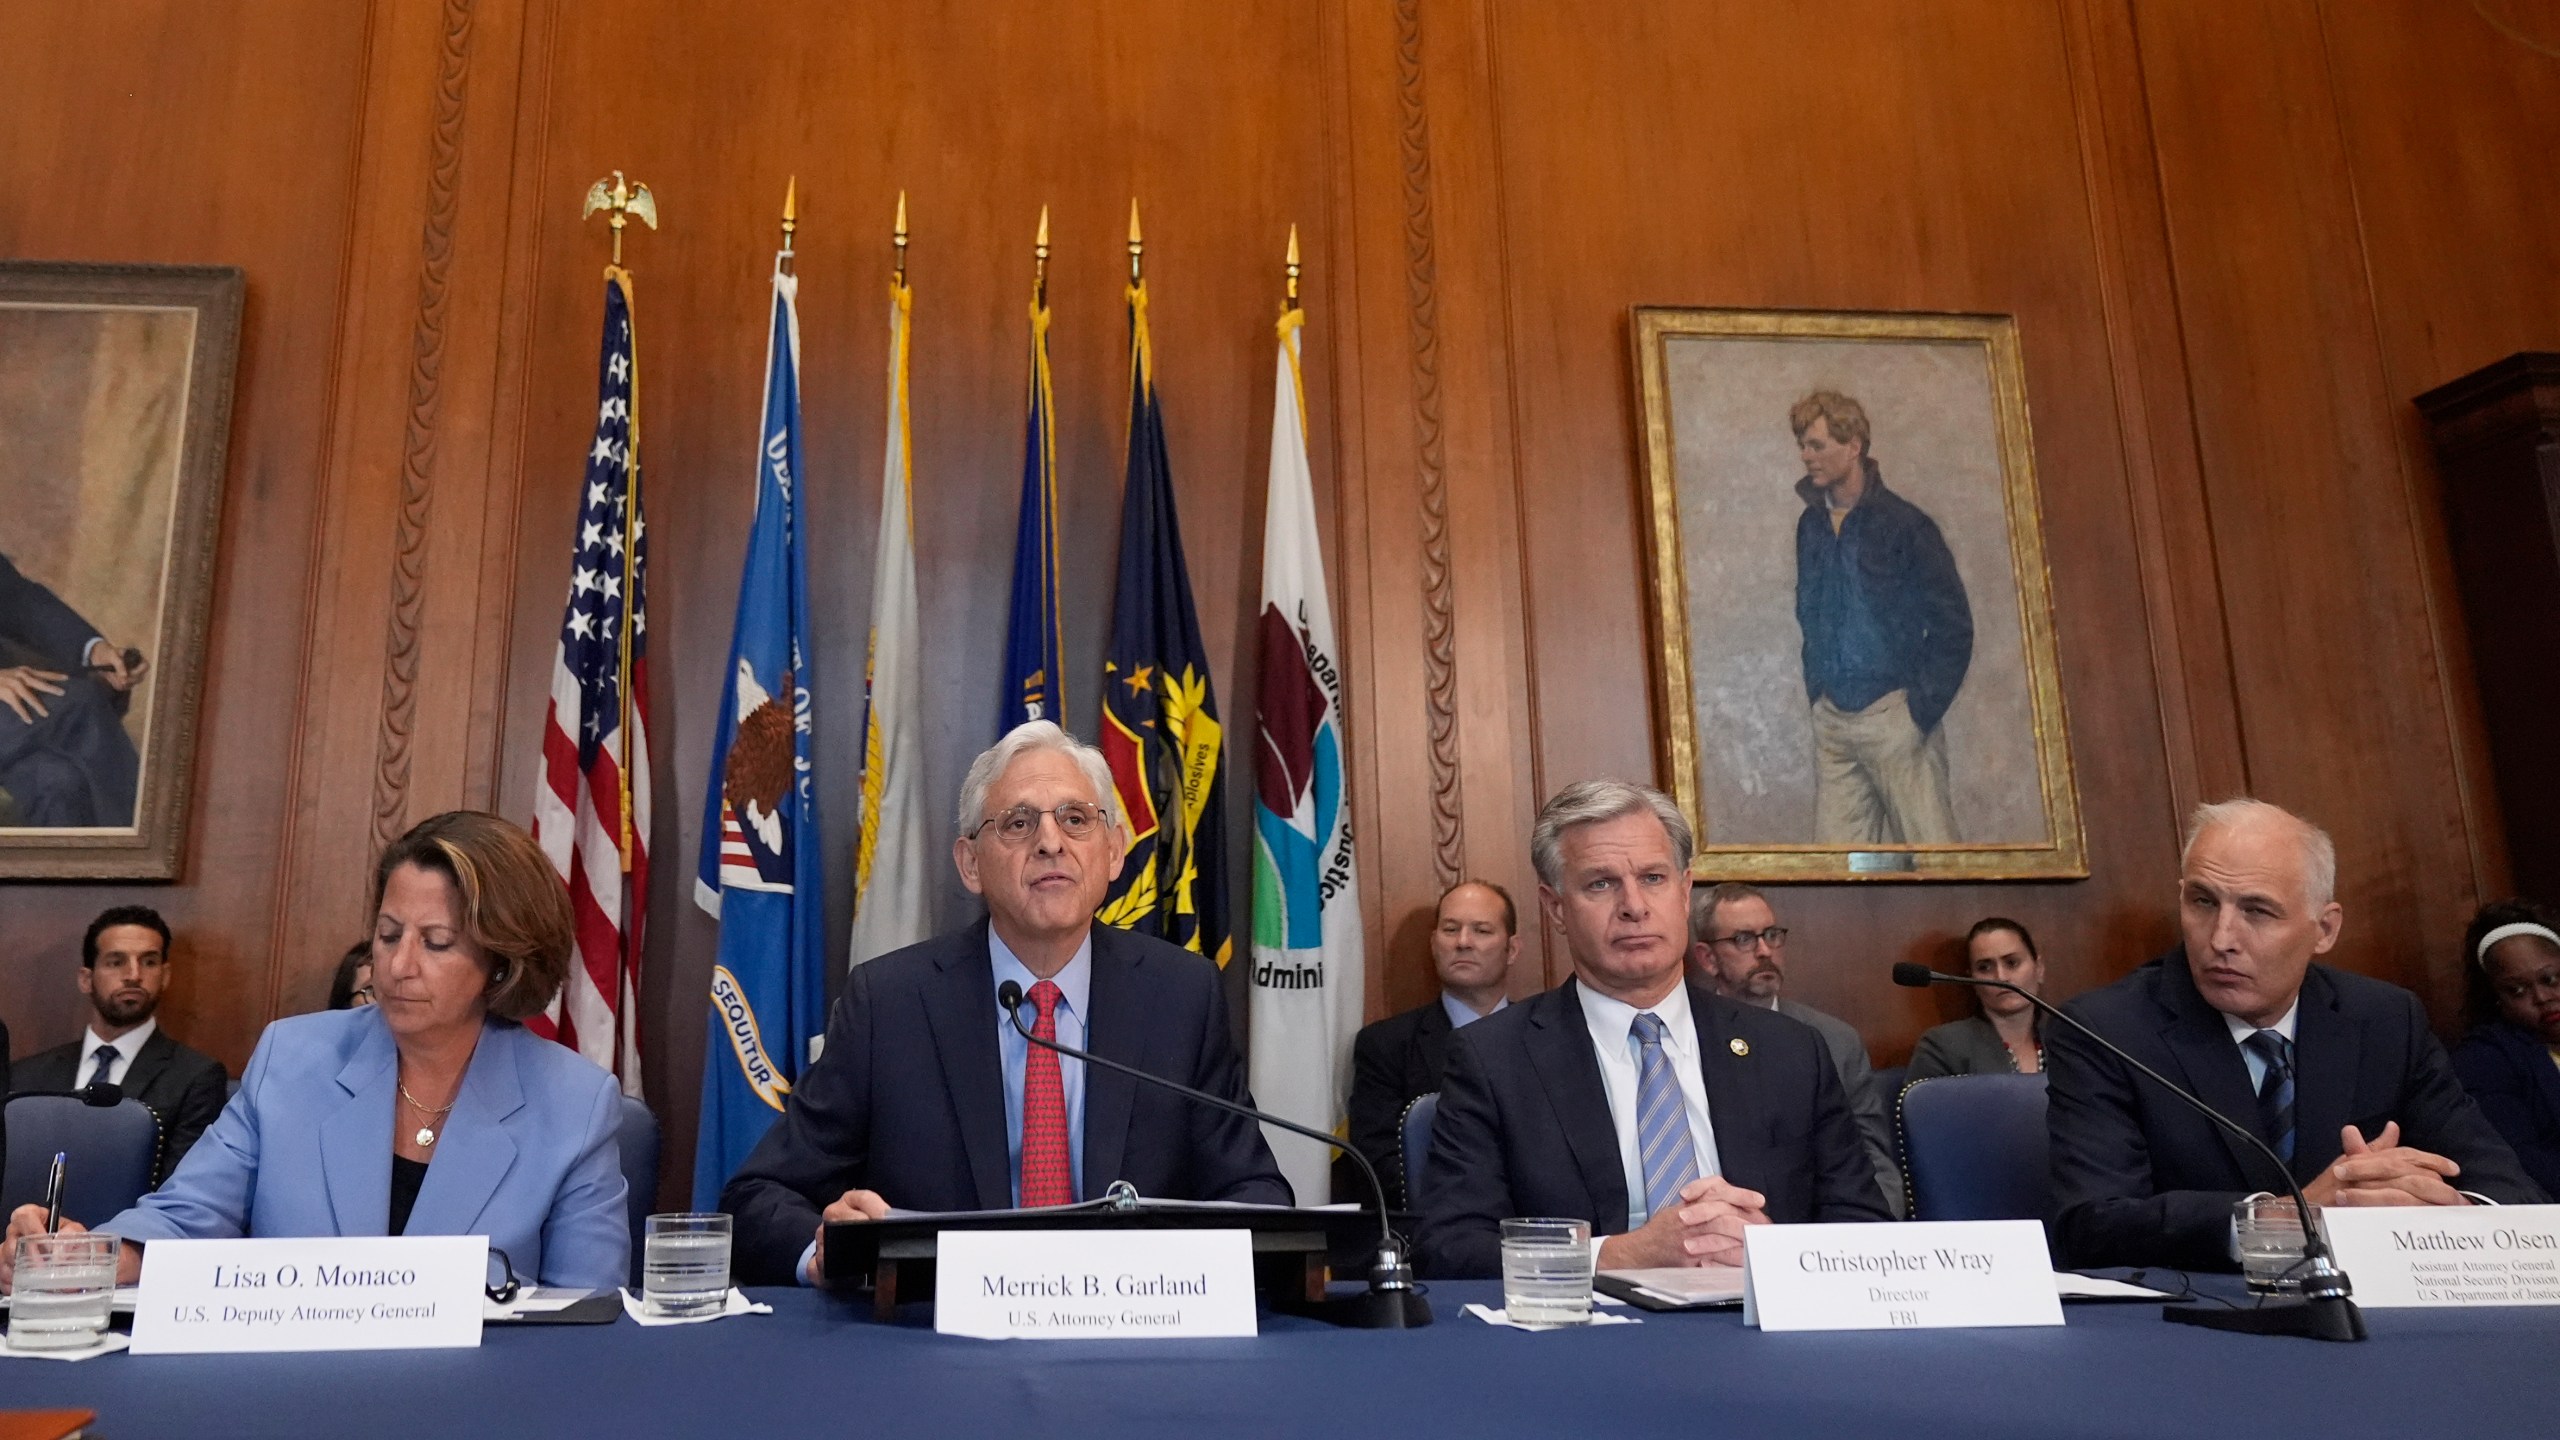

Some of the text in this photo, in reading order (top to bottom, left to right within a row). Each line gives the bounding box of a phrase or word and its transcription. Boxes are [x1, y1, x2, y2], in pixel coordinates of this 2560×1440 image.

[713, 980, 771, 1085] SEQUITUR
[2391, 1228, 2558, 1251] Matthew Olsen
[1799, 1247, 1994, 1278] Christopher Wray
[2410, 1259, 2556, 1274] Assistant Attorney General
[213, 1264, 416, 1289] Lisa O. Monaco
[982, 1272, 1207, 1297] Merrick B. Garland
[2413, 1273, 2559, 1289] National Security Division
[1868, 1286, 1930, 1303] Director
[2417, 1290, 2442, 1301] U.S.
[2445, 1290, 2509, 1303] Department
[2511, 1288, 2523, 1300] of
[173, 1301, 437, 1327] U.S. Deputy Attorney General
[1008, 1309, 1182, 1330] U.S. Attorney General
[1889, 1311, 1919, 1326] FBI
